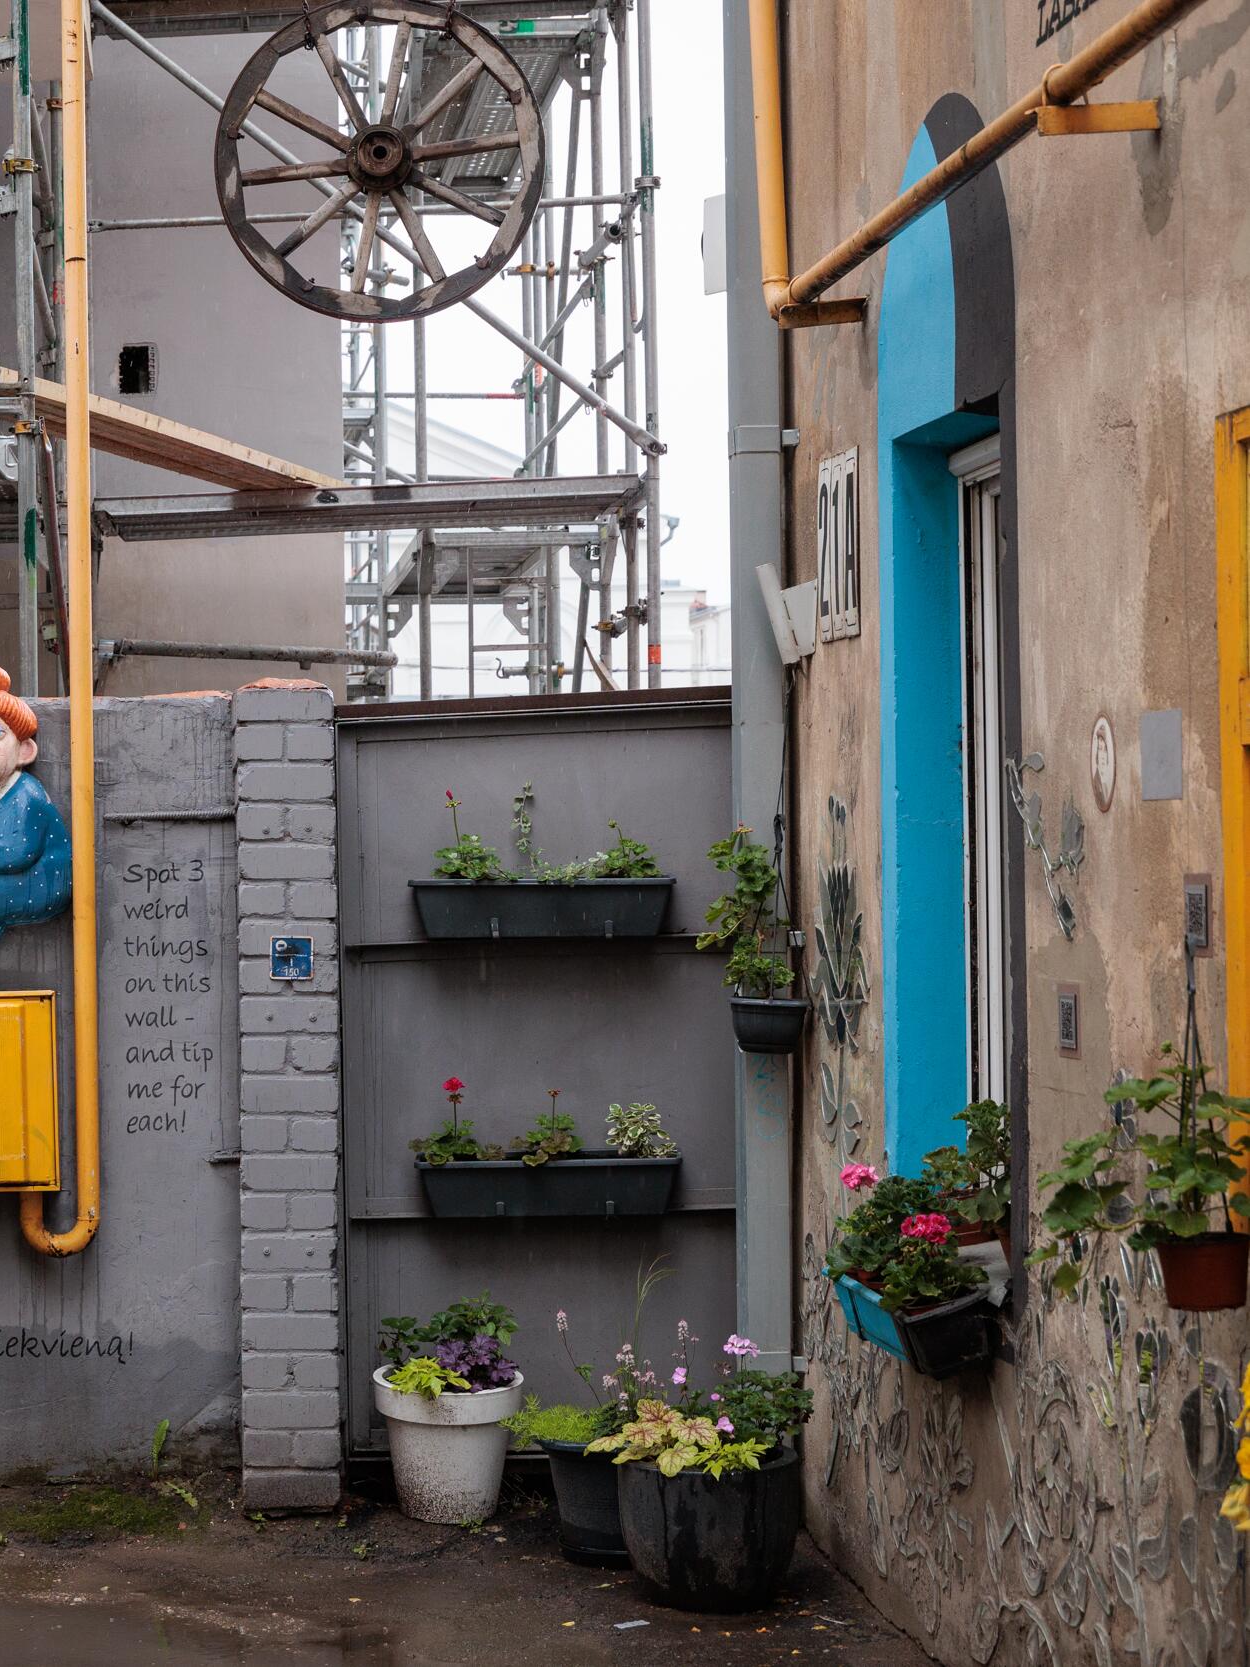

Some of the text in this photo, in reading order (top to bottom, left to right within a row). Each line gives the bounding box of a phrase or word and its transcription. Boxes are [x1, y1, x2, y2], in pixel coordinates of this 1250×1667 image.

[819, 471, 858, 618] 21A
[123, 859, 205, 894] Spot 3
[123, 895, 189, 921] weird
[123, 935, 208, 964] things
[125, 972, 212, 994] on this
[125, 1004, 177, 1028] wall
[125, 1039, 214, 1073] and tip
[127, 1074, 206, 1107] me for
[126, 1109, 187, 1134] each!
